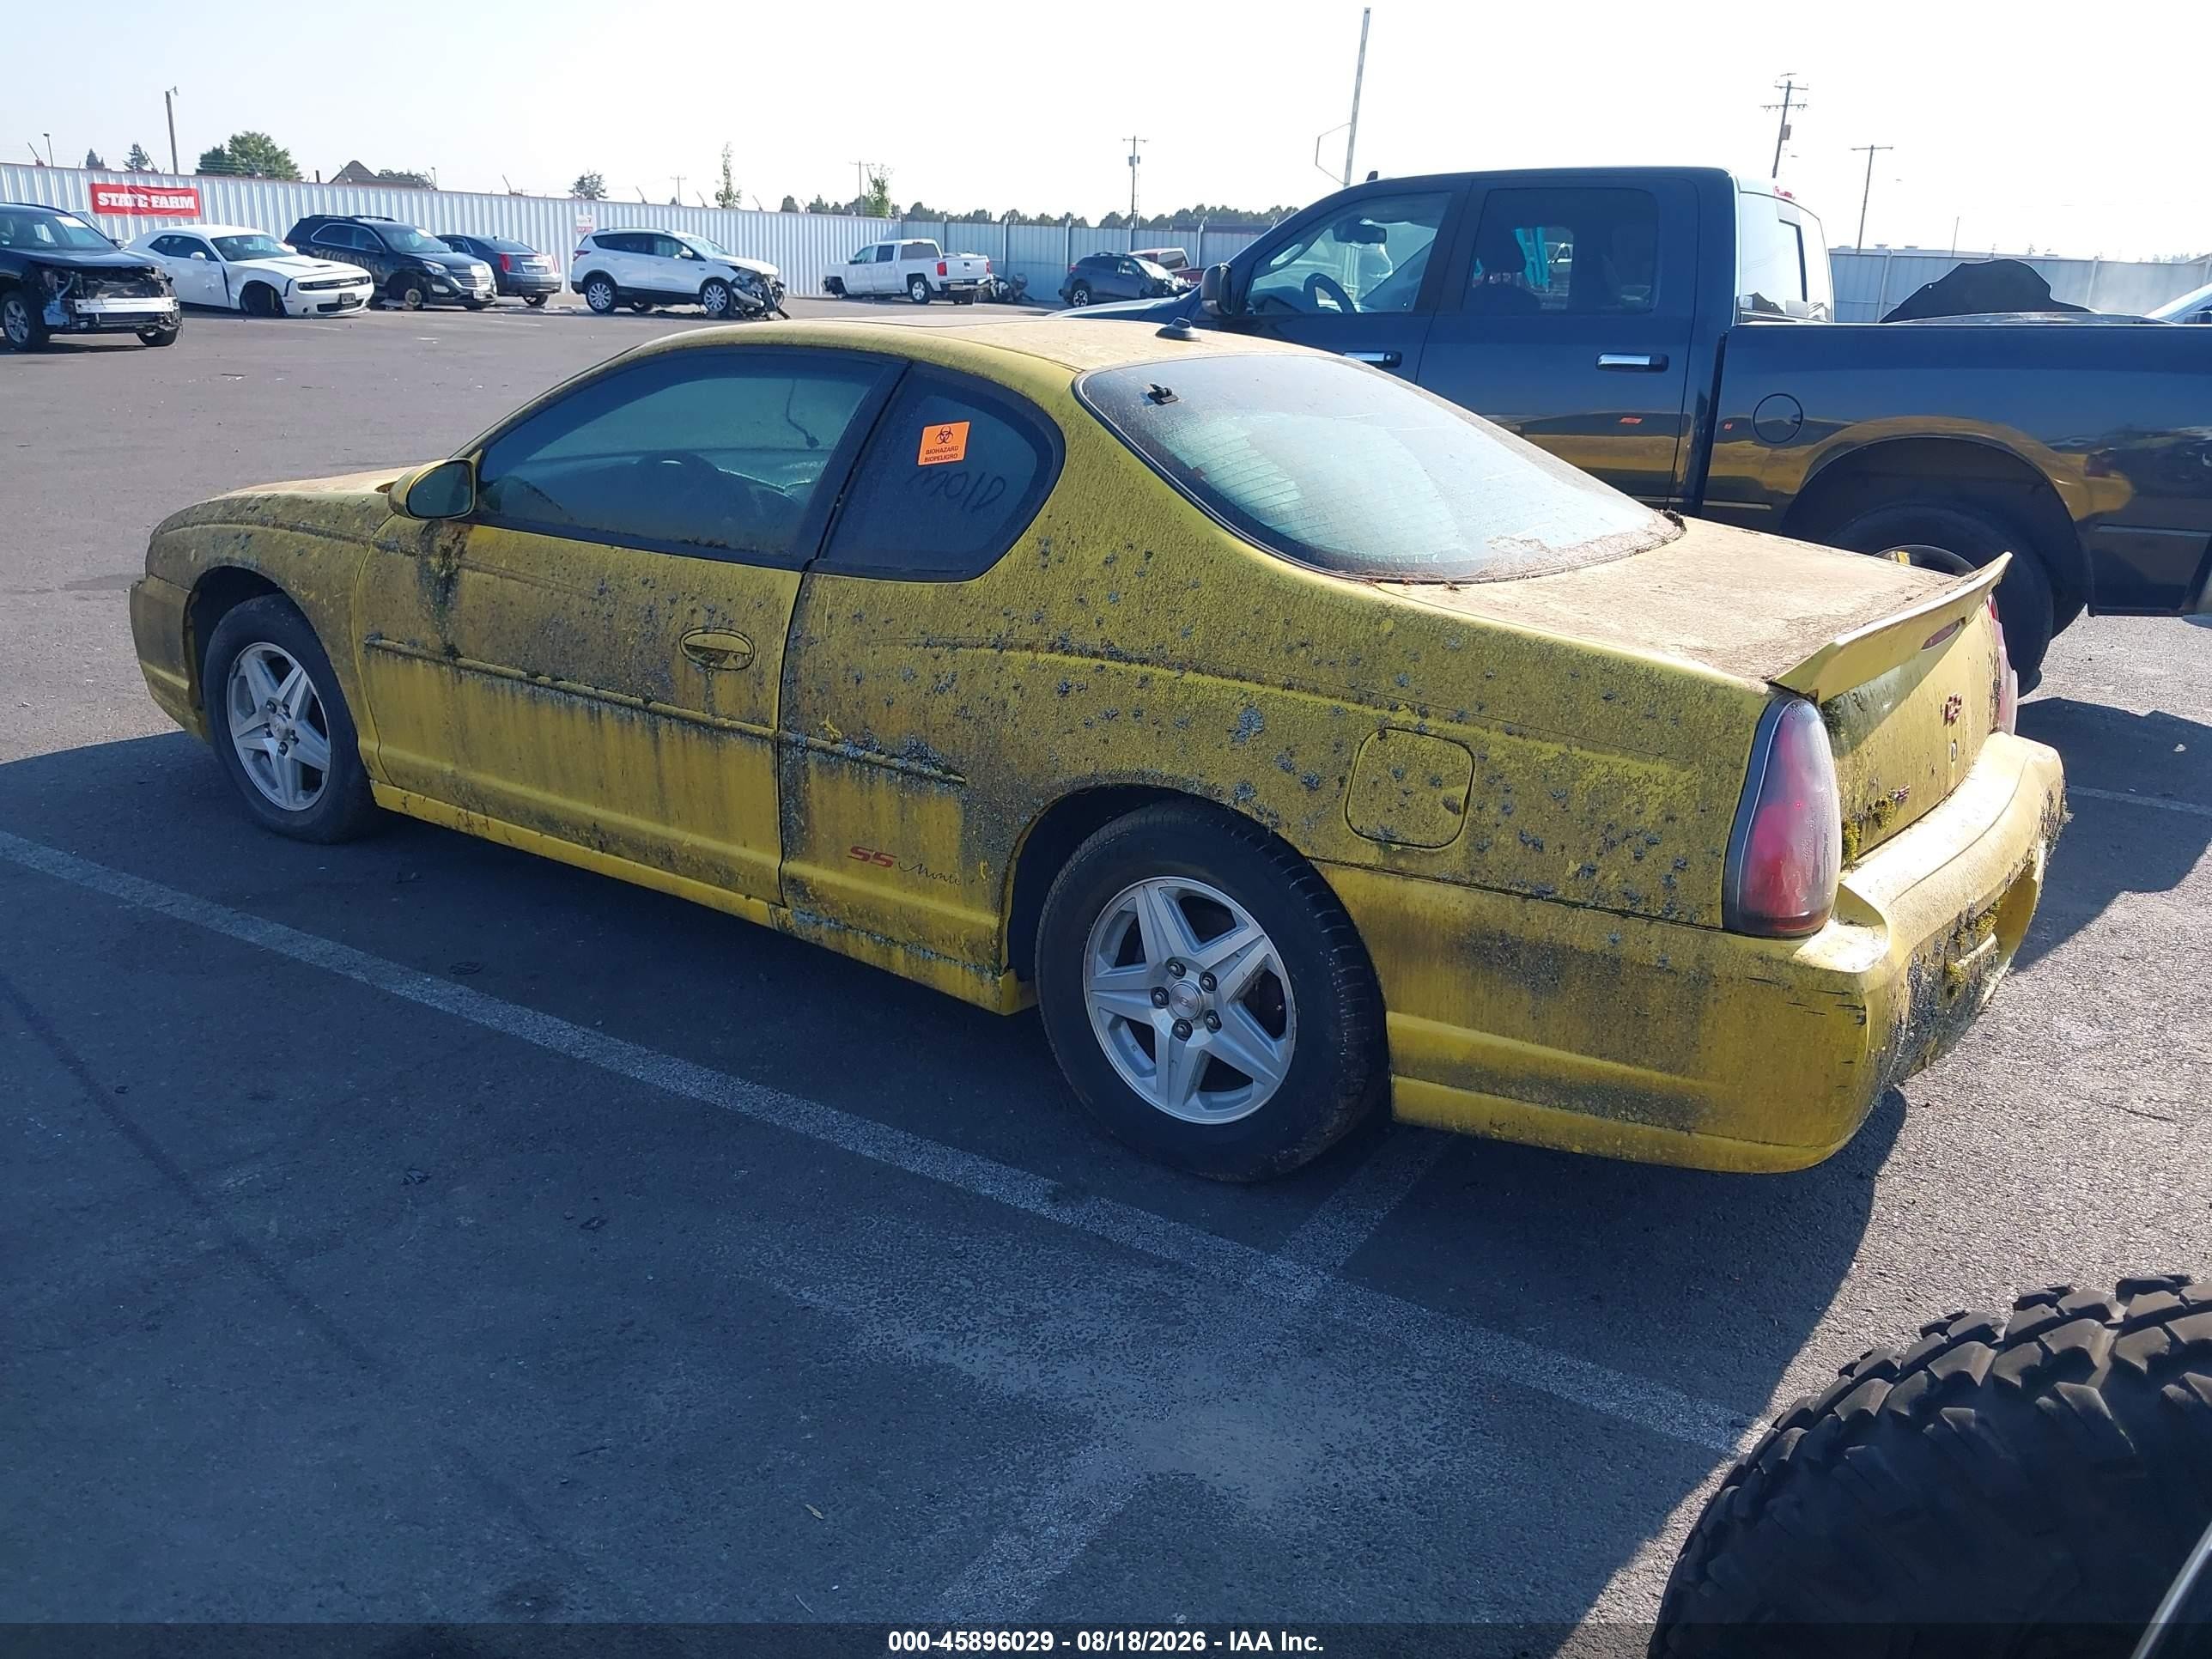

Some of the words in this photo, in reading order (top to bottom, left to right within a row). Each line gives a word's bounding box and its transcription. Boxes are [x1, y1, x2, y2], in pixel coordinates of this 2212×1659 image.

[150, 195, 196, 210] FARM
[925, 445, 959, 455] BIOHAZARD
[924, 453, 958, 463] BIOPELIGRO
[847, 845, 897, 869] SS
[898, 861, 962, 886] Monte
